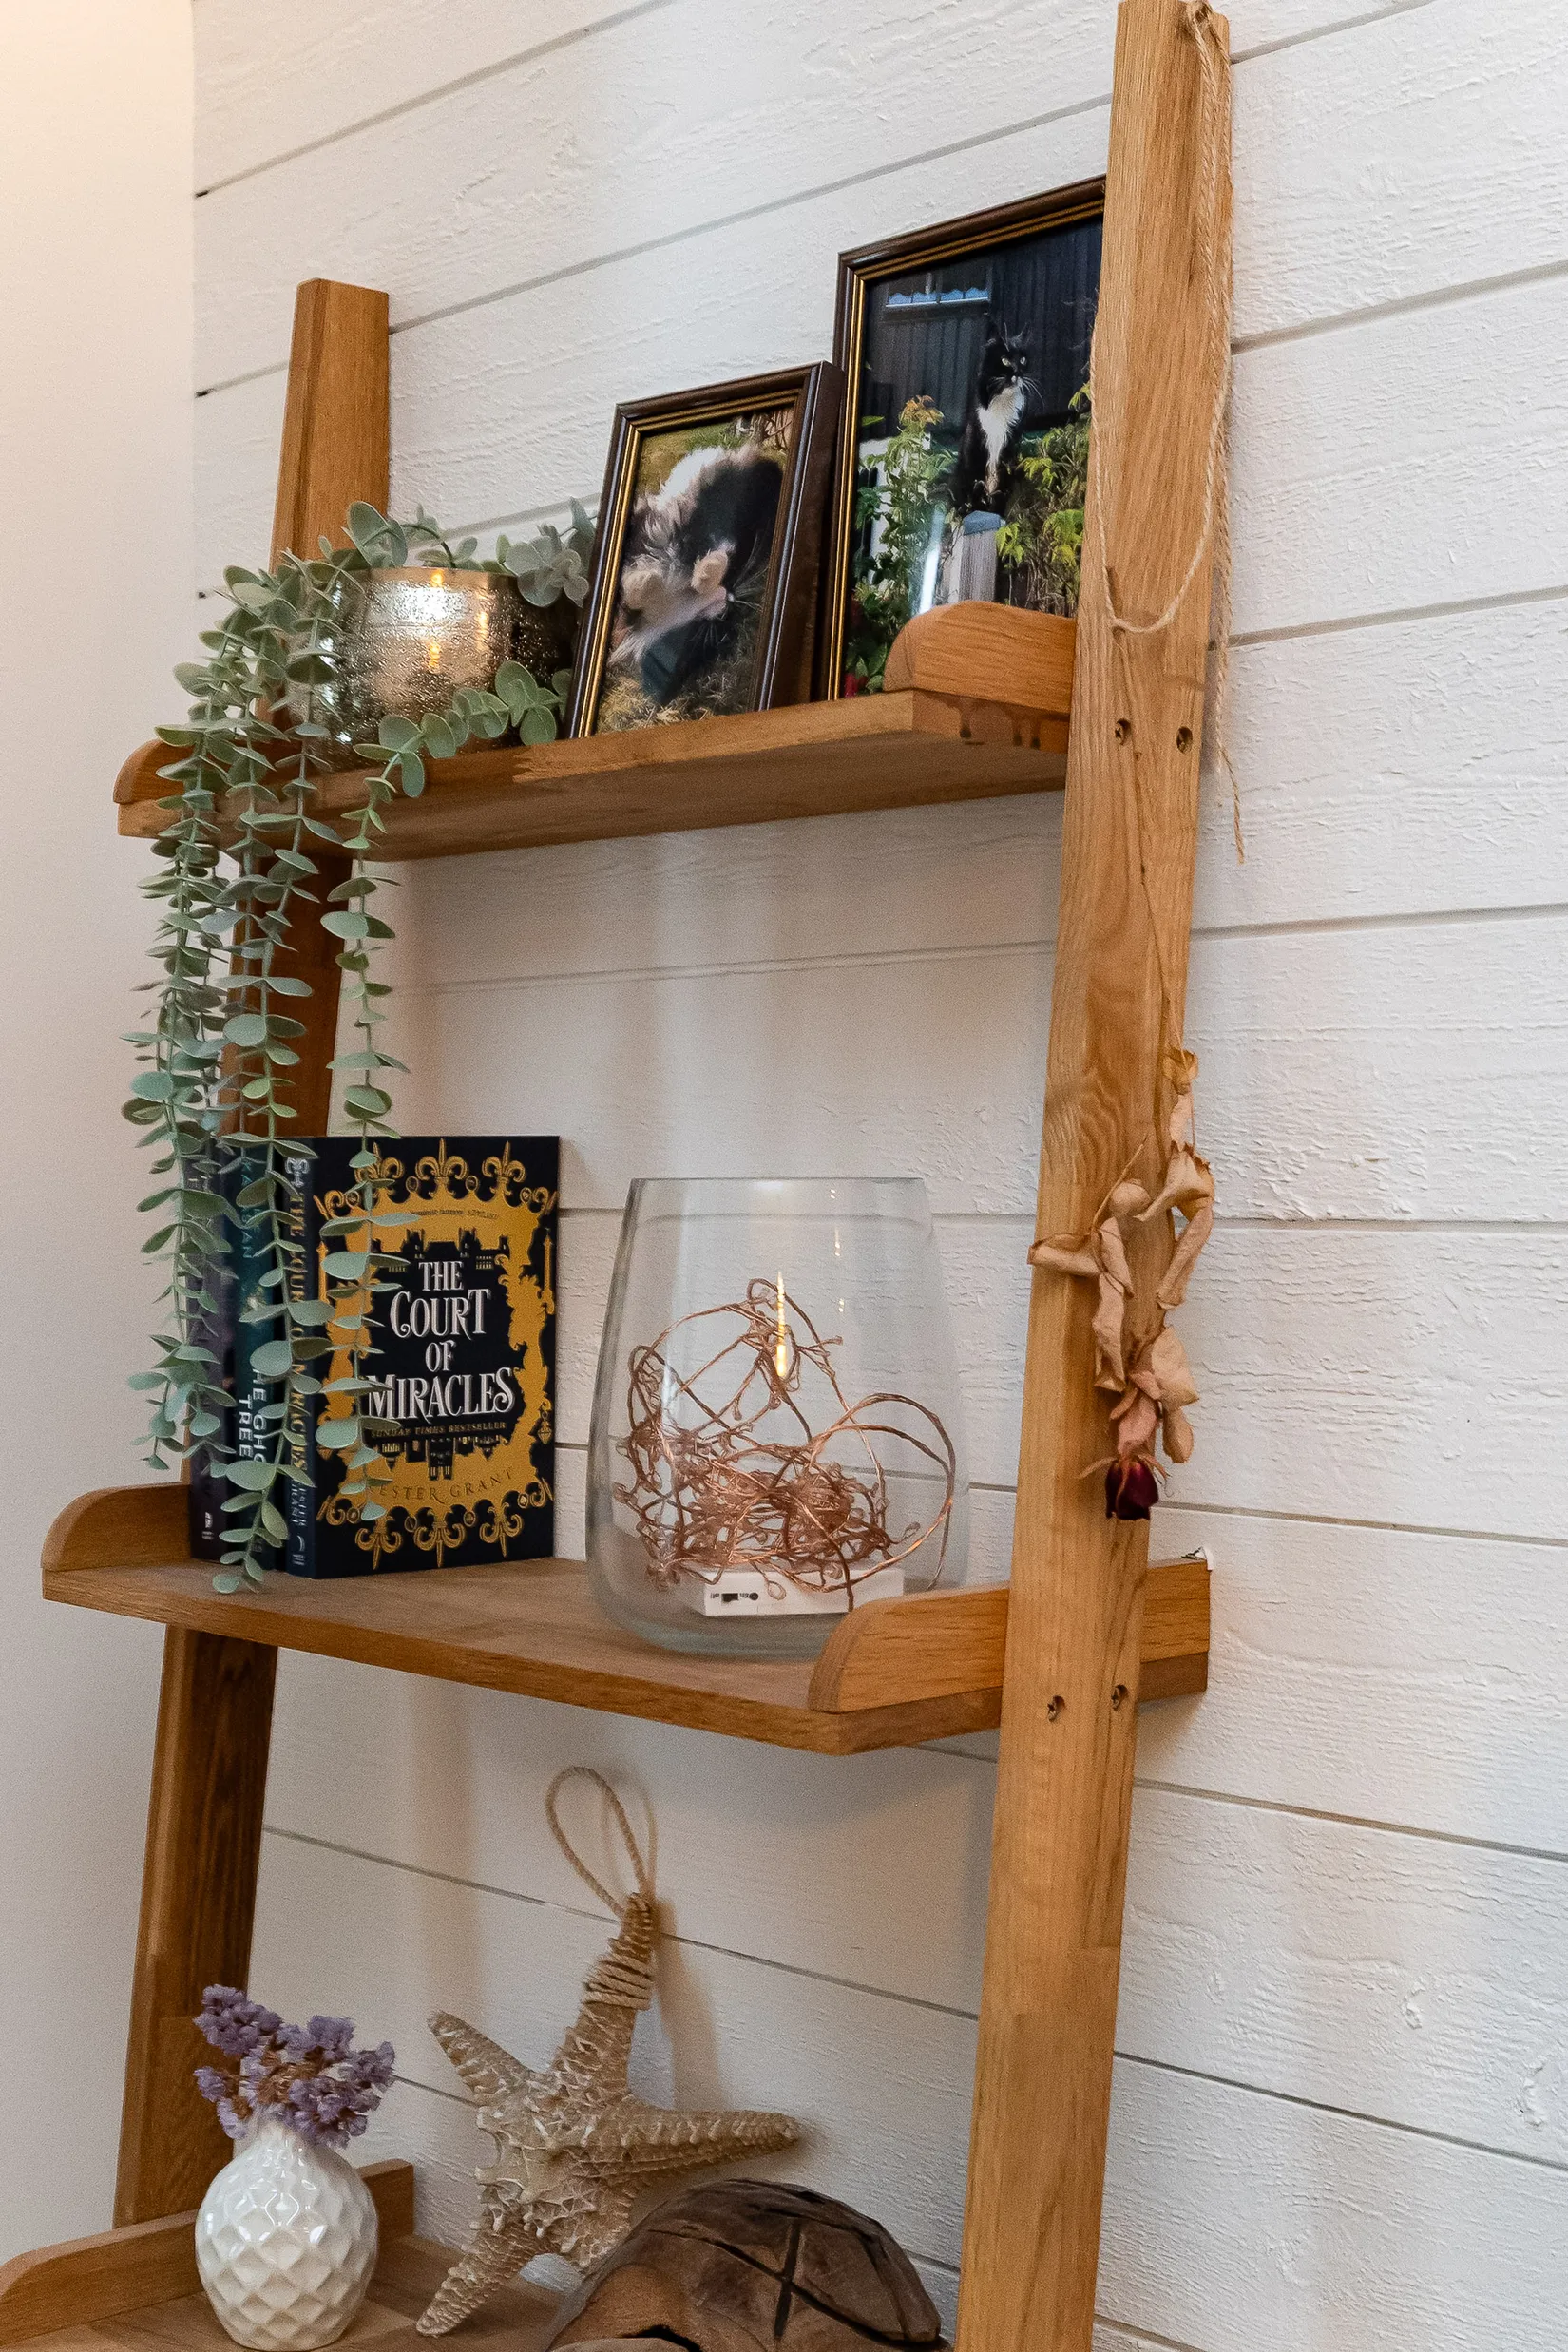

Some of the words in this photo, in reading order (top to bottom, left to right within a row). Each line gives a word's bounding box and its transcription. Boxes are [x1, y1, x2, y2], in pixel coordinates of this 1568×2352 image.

[418, 1260, 465, 1291] THE
[390, 1288, 492, 1341] COURT
[425, 1339, 456, 1373] OF
[252, 1368, 268, 1402] HE
[366, 1367, 516, 1425] MIRACLES
[239, 1393, 253, 1458] TREE
[371, 1427, 411, 1439] SUNDAY
[414, 1425, 446, 1436] TIMES
[448, 1421, 507, 1433] BESTSELLER
[449, 1465, 514, 1498] GRANT
